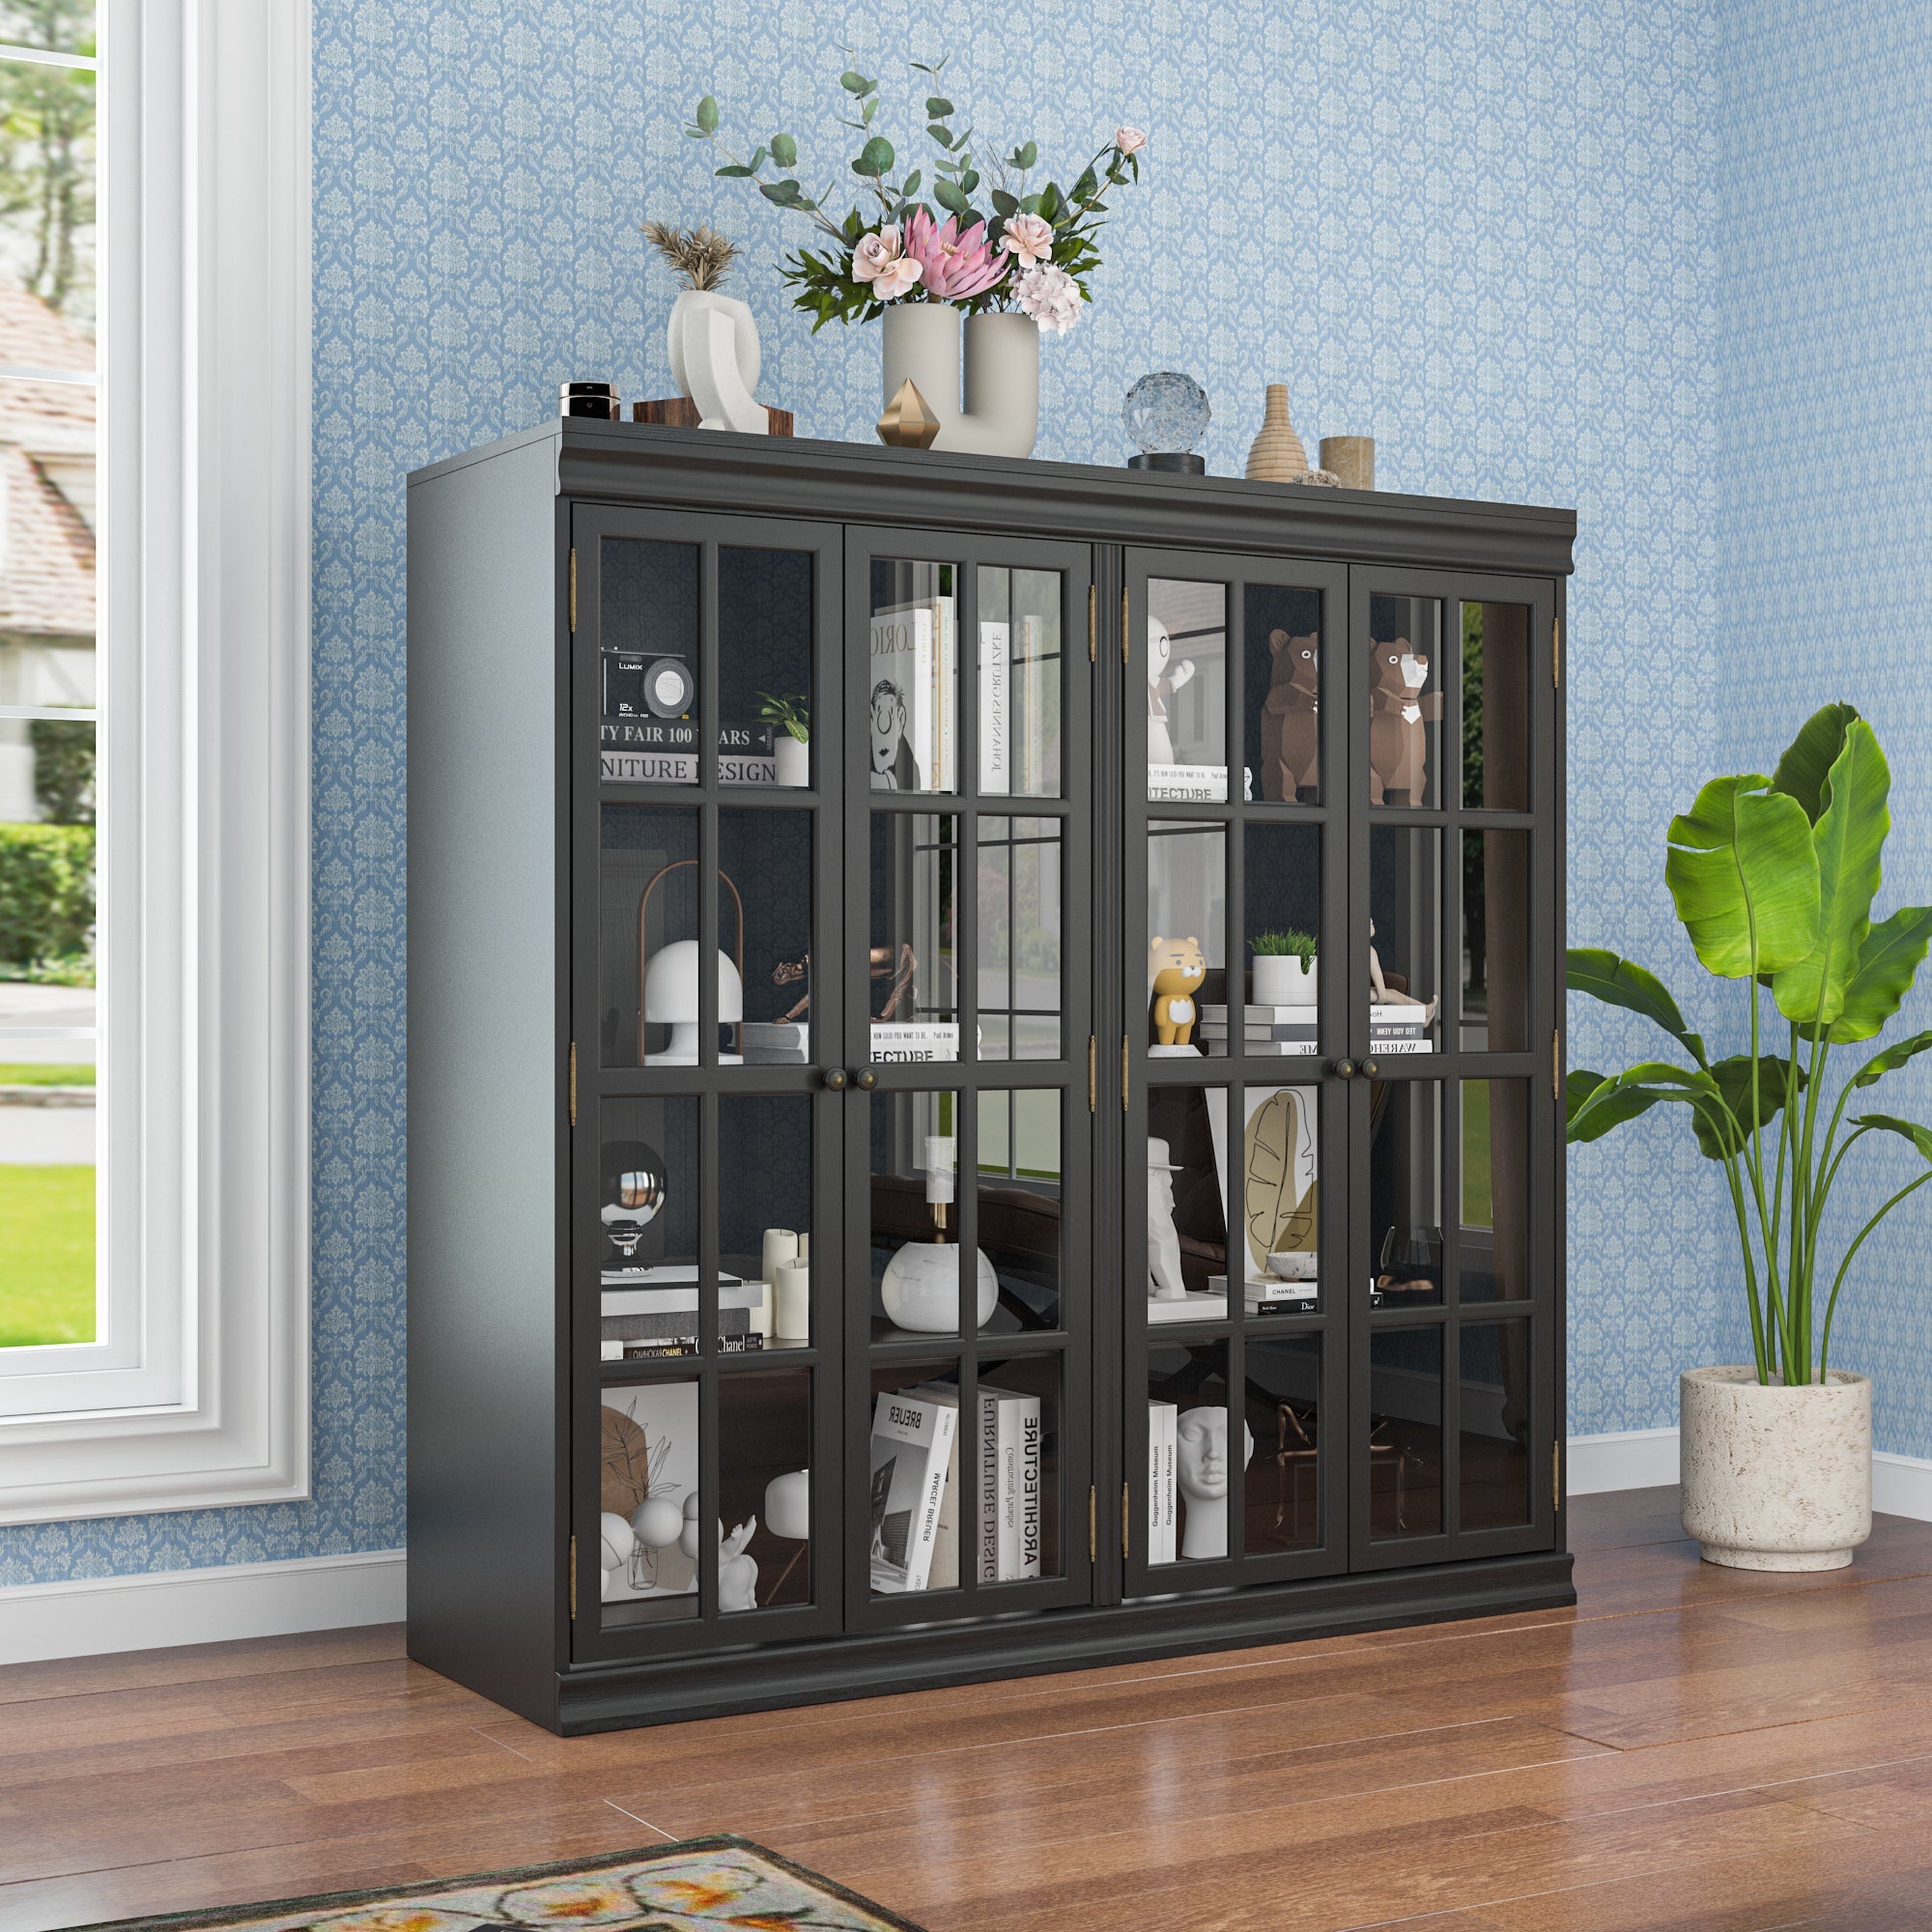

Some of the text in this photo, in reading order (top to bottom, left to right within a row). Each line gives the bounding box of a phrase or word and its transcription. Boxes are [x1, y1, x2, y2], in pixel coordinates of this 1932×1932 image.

[623, 725, 664, 743] FAIR
[668, 727, 693, 743] 100
[695, 759, 777, 781] ESIGN
[870, 1050, 934, 1062] ECTURE
[1300, 1301, 1315, 1311] Dior
[662, 1347, 683, 1357] CHANEL
